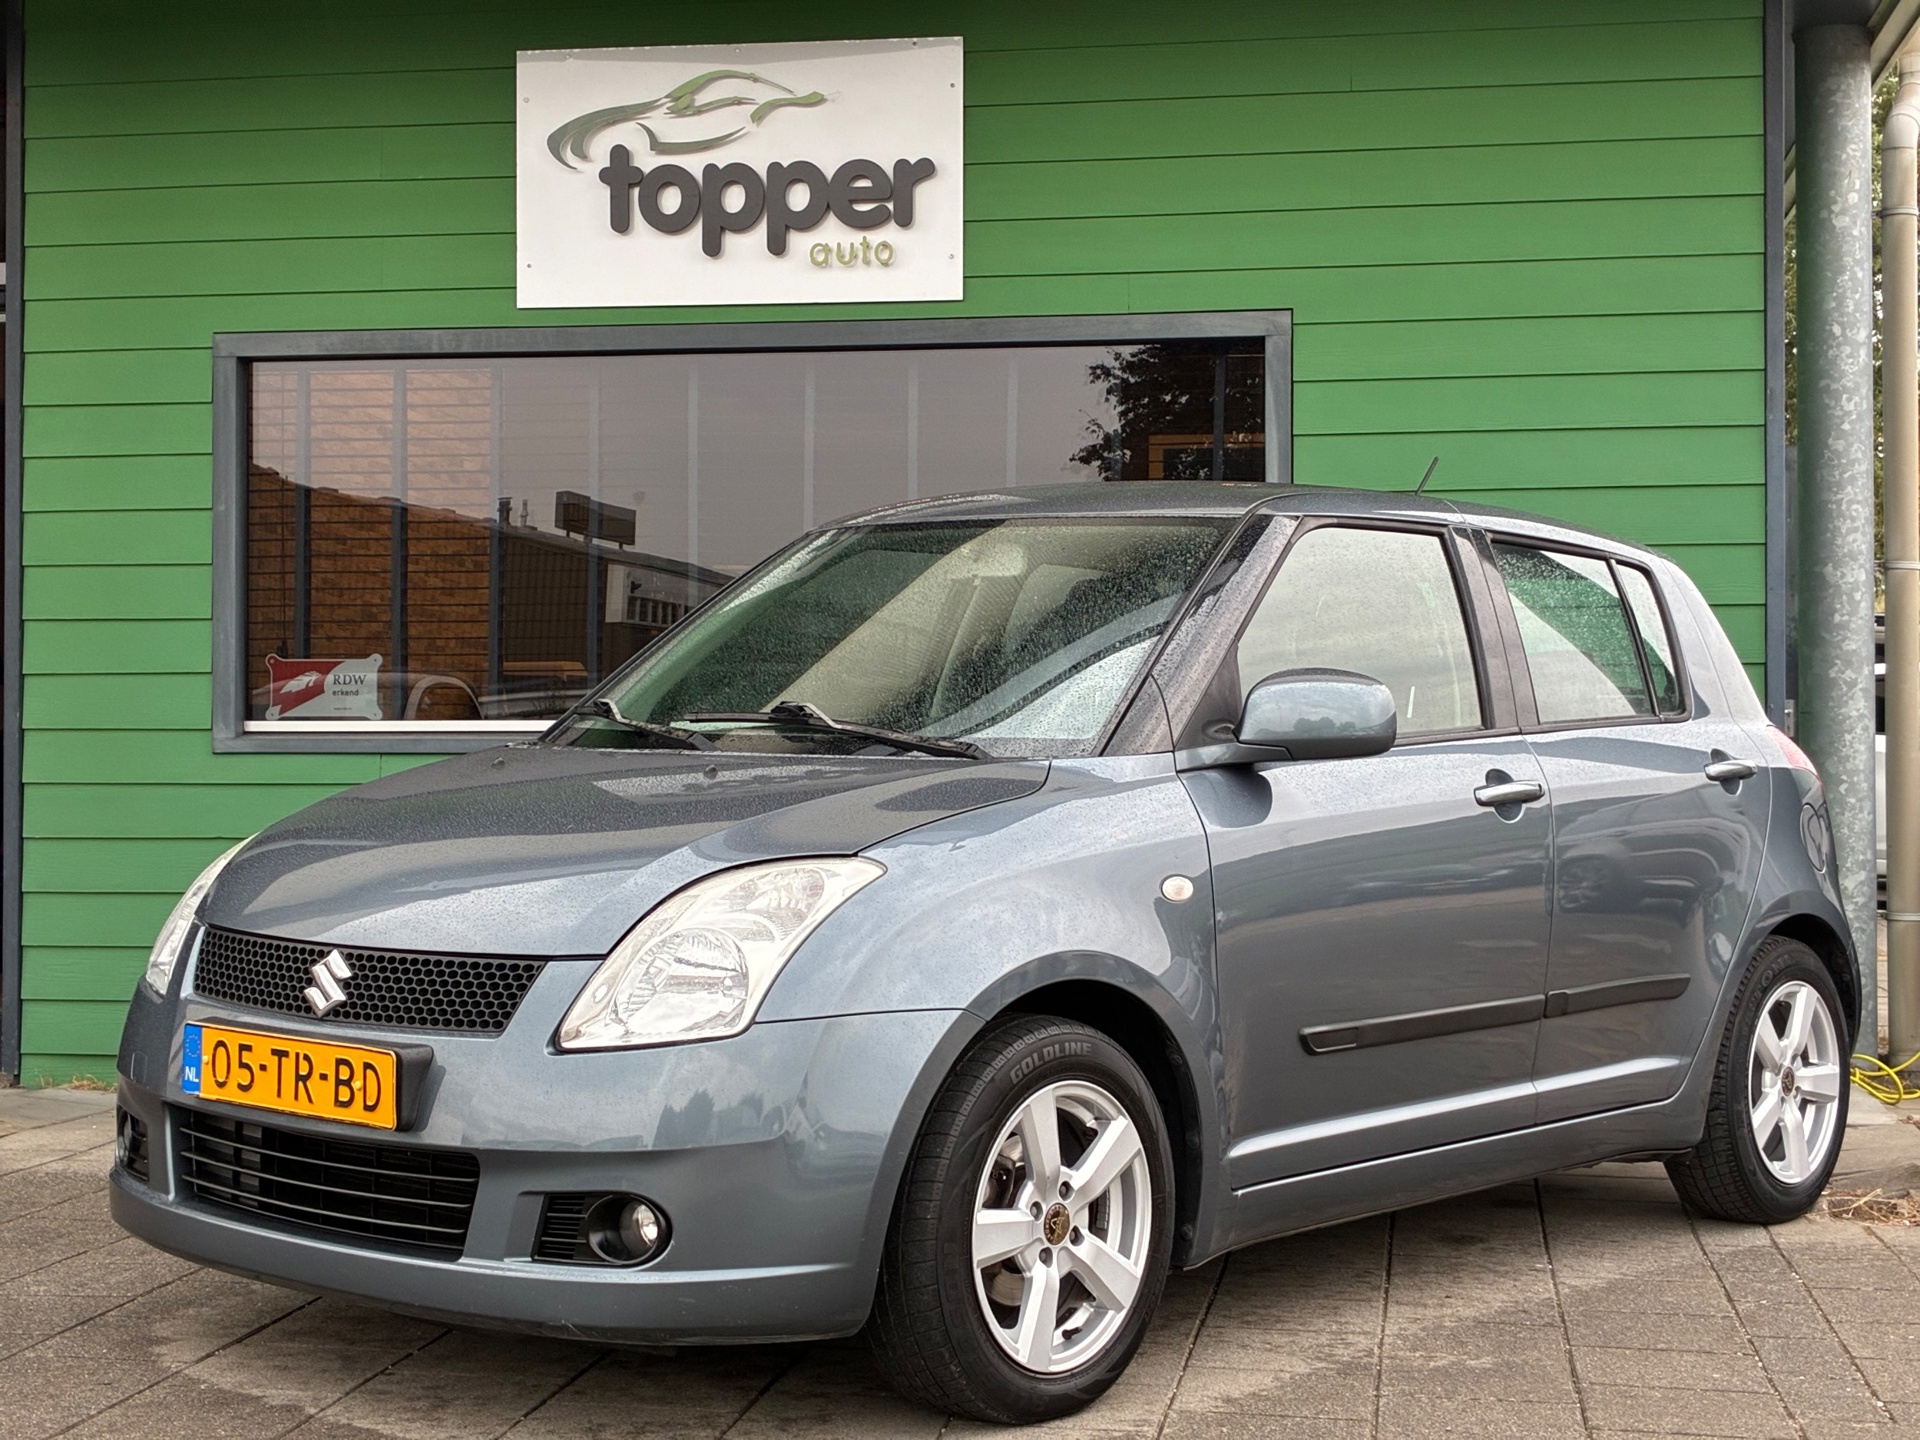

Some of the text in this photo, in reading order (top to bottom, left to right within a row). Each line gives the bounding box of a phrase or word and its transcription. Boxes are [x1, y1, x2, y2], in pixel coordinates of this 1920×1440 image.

[599, 144, 935, 257] topper
[810, 236, 894, 266] auto
[332, 688, 359, 697] erkend
[333, 674, 367, 686] RDW
[185, 1065, 199, 1082] NL
[211, 1039, 382, 1113] 05-TR-BD
[1009, 1041, 1093, 1084] GOLDLINE
